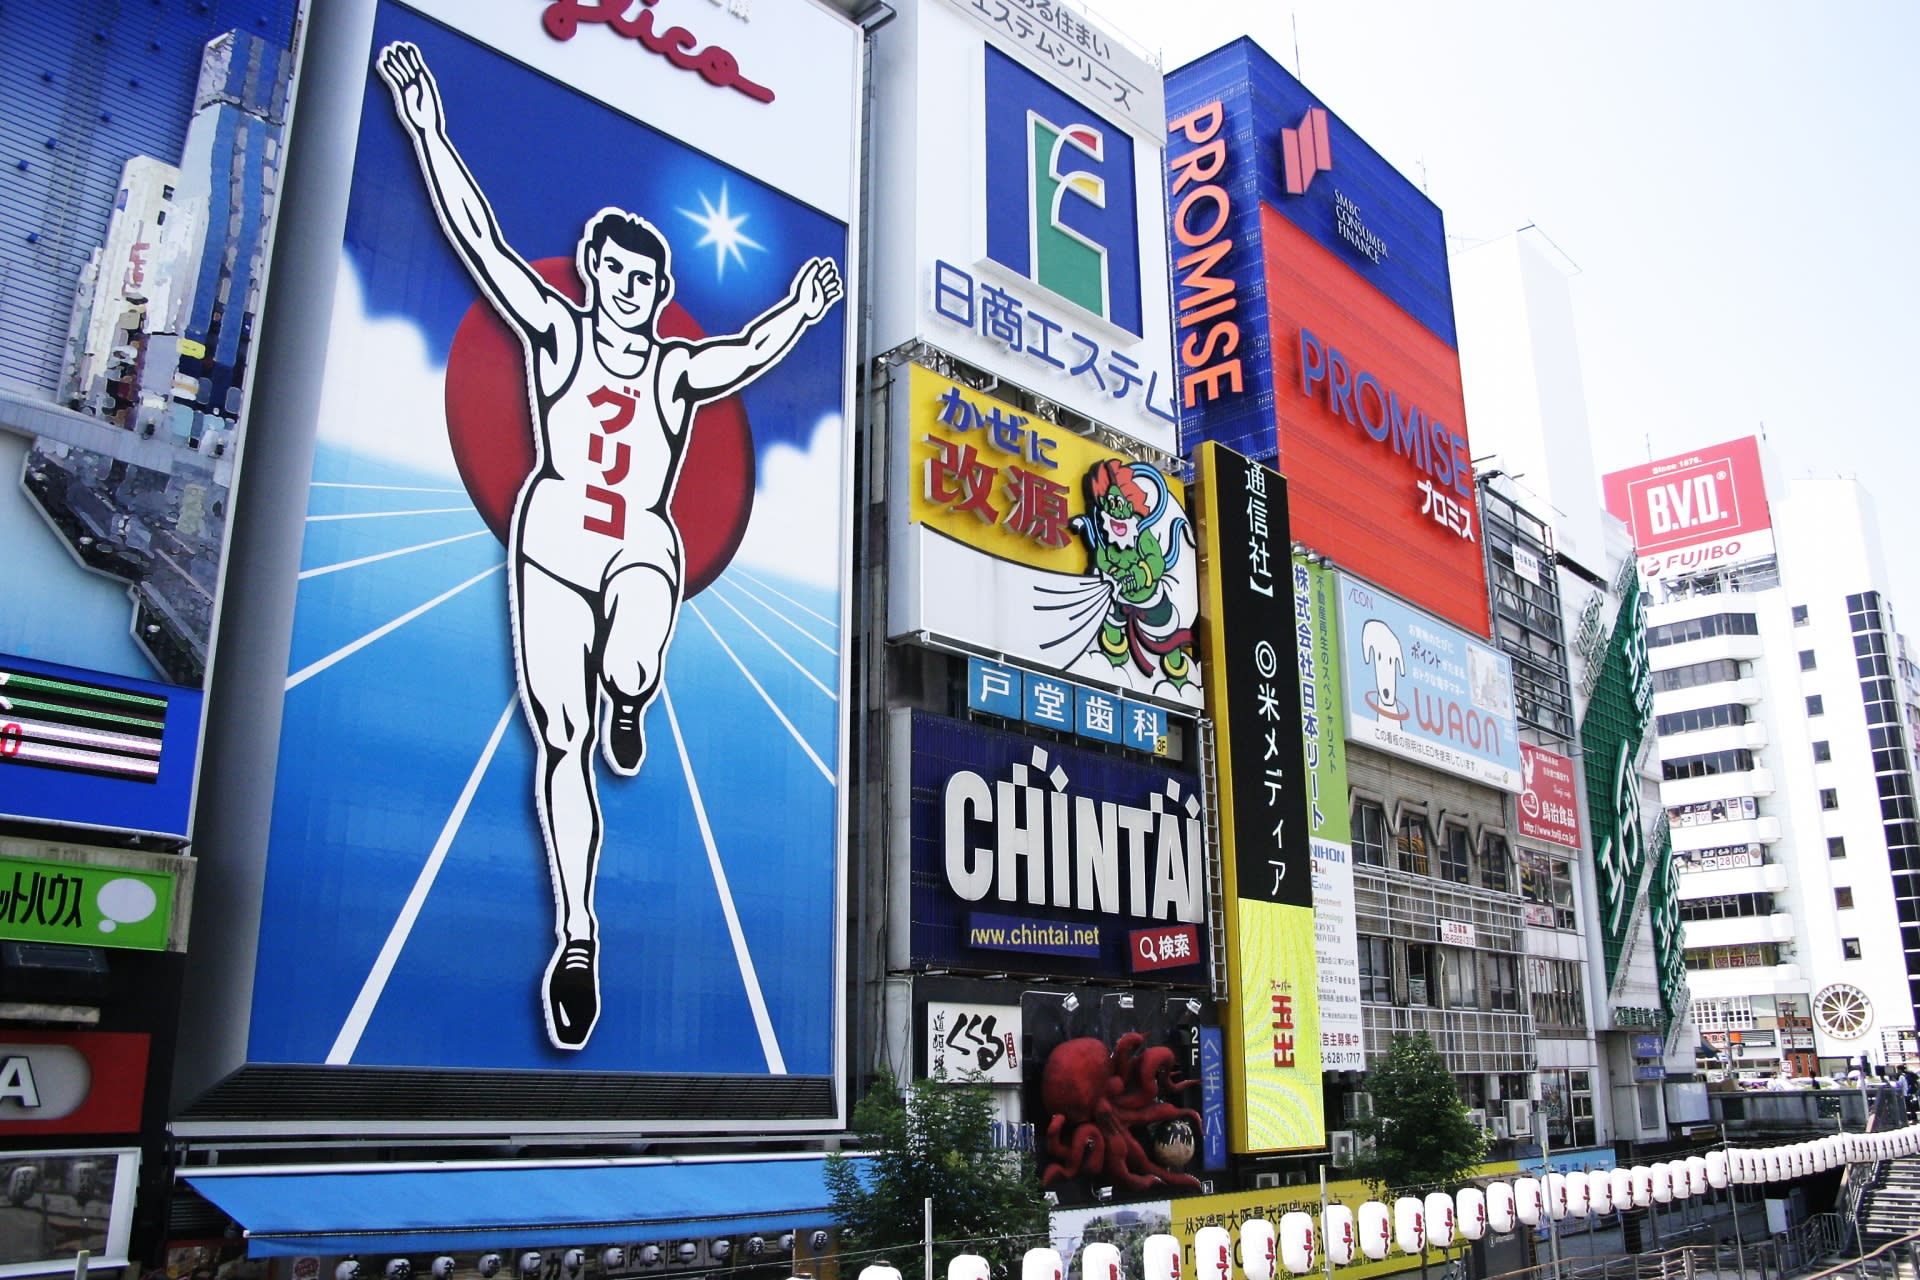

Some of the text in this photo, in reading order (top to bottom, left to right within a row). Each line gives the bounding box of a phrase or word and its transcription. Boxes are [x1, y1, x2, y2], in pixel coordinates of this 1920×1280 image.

[1334, 188, 1361, 223] SMBC
[1335, 204, 1389, 258] CONSUMER
[1168, 100, 1244, 409] PROMISE
[1337, 221, 1381, 265] FINANCE
[934, 258, 1180, 424] 日商エステム
[938, 387, 1059, 469] かぜに
[1299, 327, 1472, 499] PROMISE
[583, 384, 641, 541] グリコ
[924, 434, 1073, 548] 改源
[1417, 479, 1475, 543] プロミス
[1646, 473, 1729, 536] B.V.D.
[1666, 541, 1742, 569] FUJIBO
[980, 666, 1159, 746] 戸堂歯科
[1294, 563, 1325, 832] 株式会社日本リート
[1157, 739, 1167, 753] 3F
[945, 746, 1204, 924] CHINTAI
[1310, 844, 1345, 863] NIHON
[1157, 932, 1191, 961] 検索
[945, 1012, 1005, 1072] くくる
[1191, 1026, 1200, 1066] 2F
[1271, 995, 1296, 1068] 玉出
